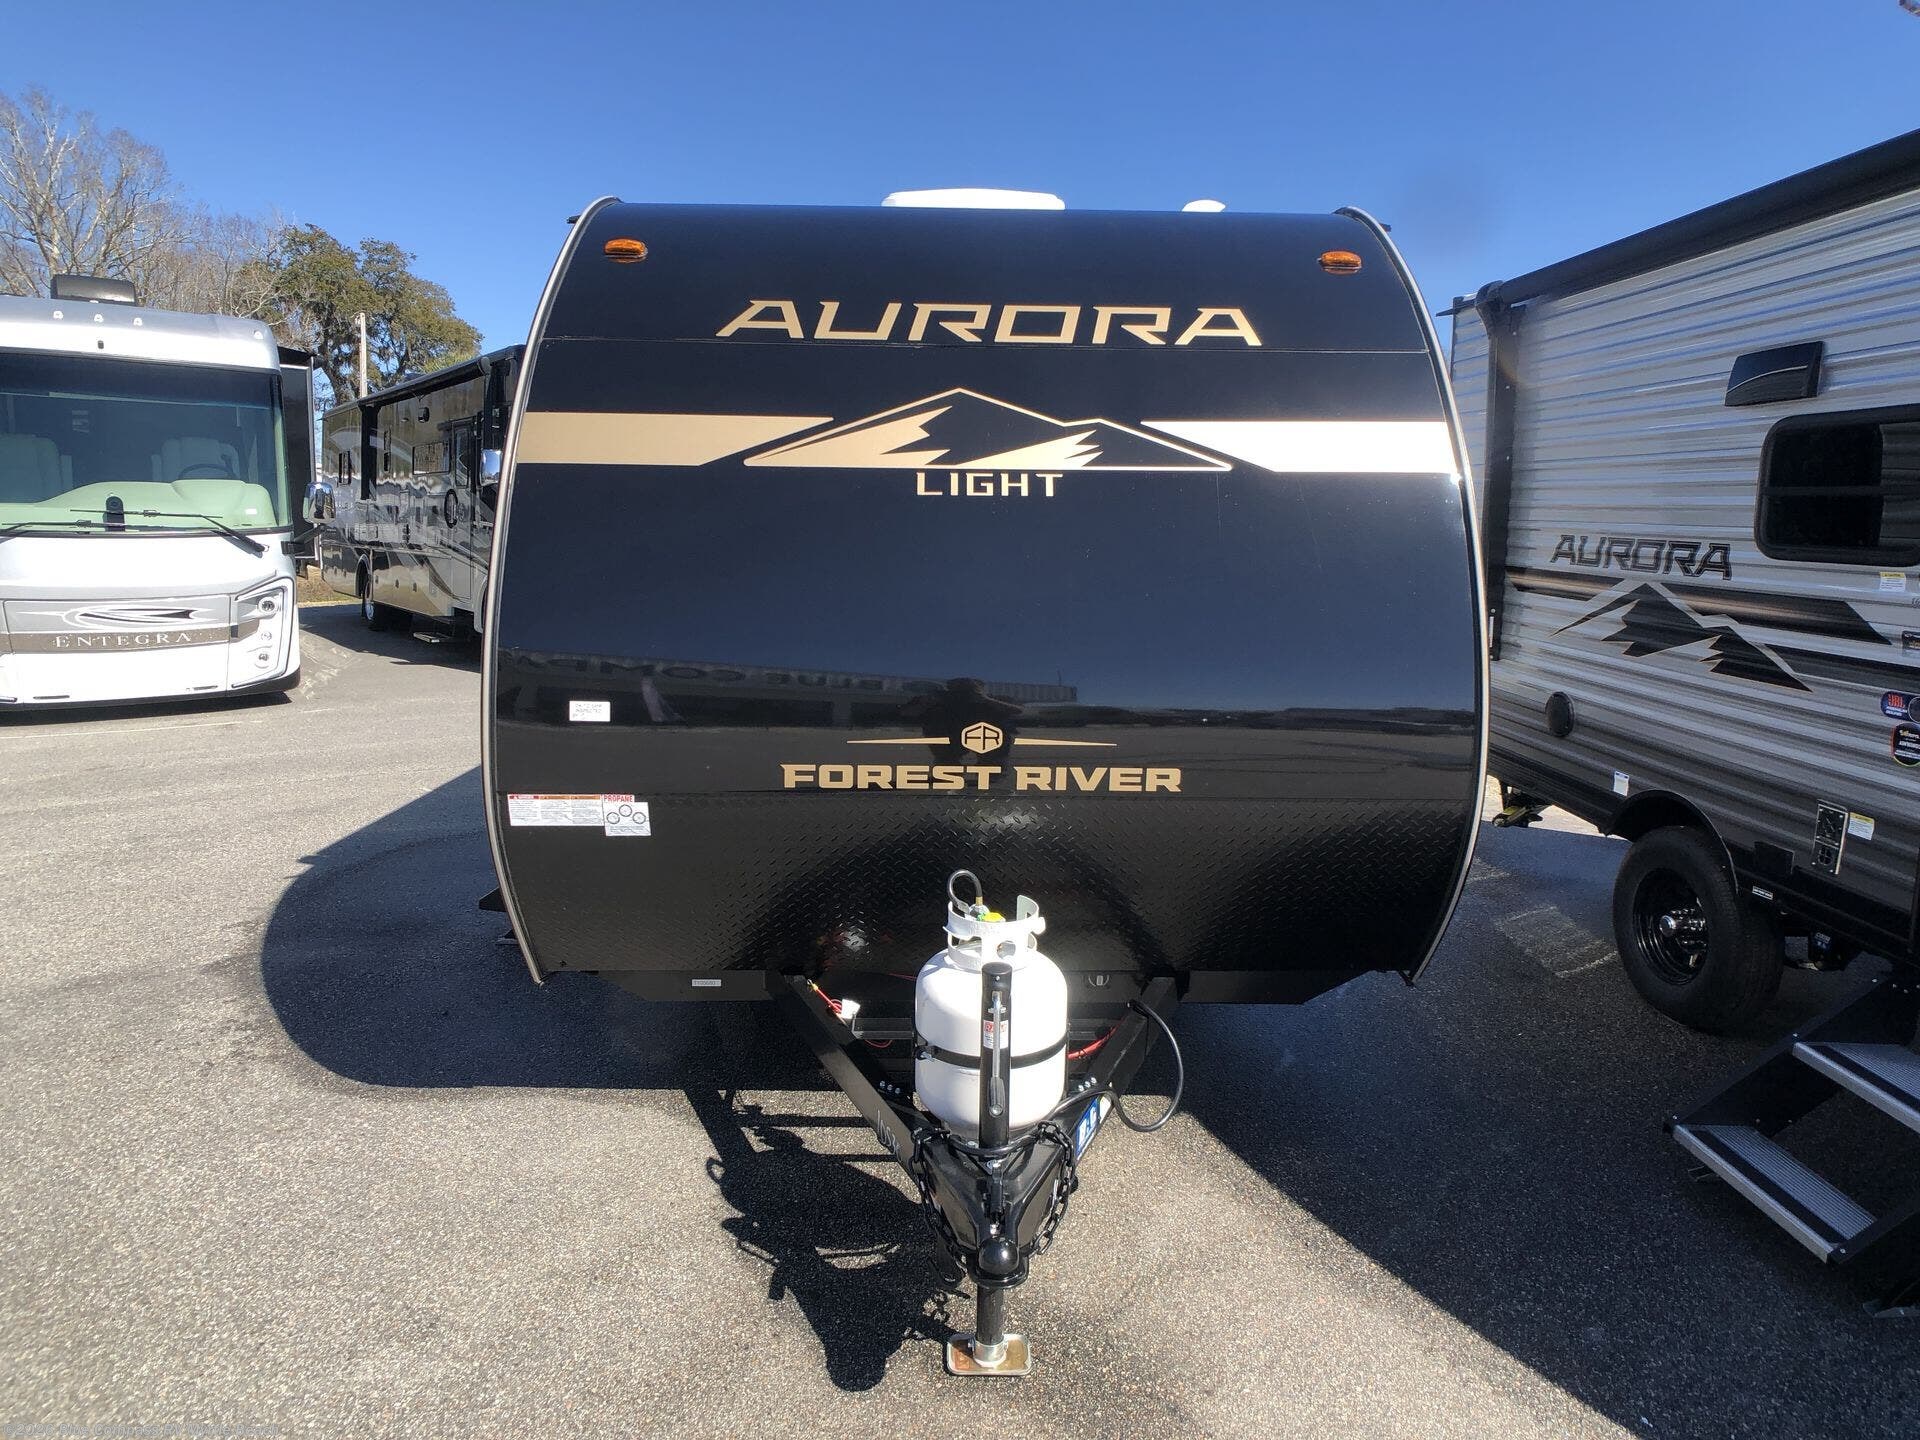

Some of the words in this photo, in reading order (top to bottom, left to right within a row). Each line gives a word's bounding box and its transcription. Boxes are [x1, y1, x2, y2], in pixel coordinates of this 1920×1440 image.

[715, 300, 1263, 347] AURORA
[916, 471, 1064, 498] LIGHT
[1550, 534, 1733, 581] AURORA
[55, 632, 192, 648] ENTEGRA
[780, 763, 1002, 791] FOREST
[1013, 765, 1183, 792] RIVER
[603, 794, 634, 803] PROPANE
